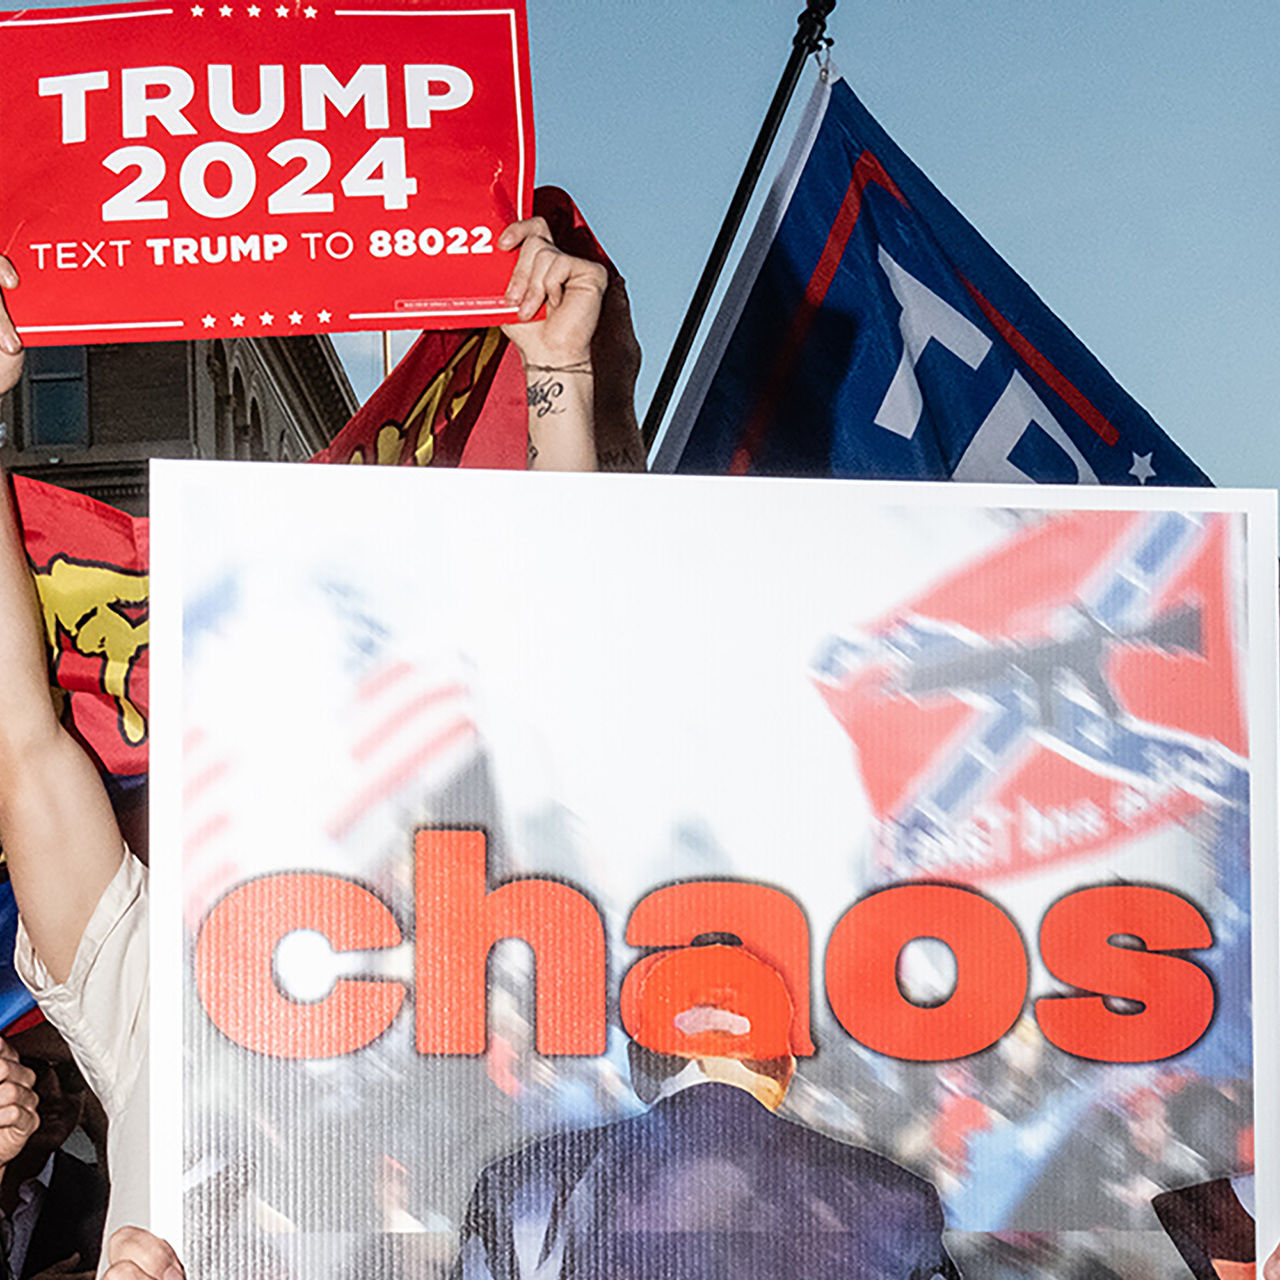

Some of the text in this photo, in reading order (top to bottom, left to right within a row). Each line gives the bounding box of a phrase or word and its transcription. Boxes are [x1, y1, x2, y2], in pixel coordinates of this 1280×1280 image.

[38, 63, 474, 144] TRUMP
[101, 136, 418, 222] 2024
[29, 226, 494, 271] TEXT TRUMP TO 88022
[195, 826, 1216, 1063] chaos
